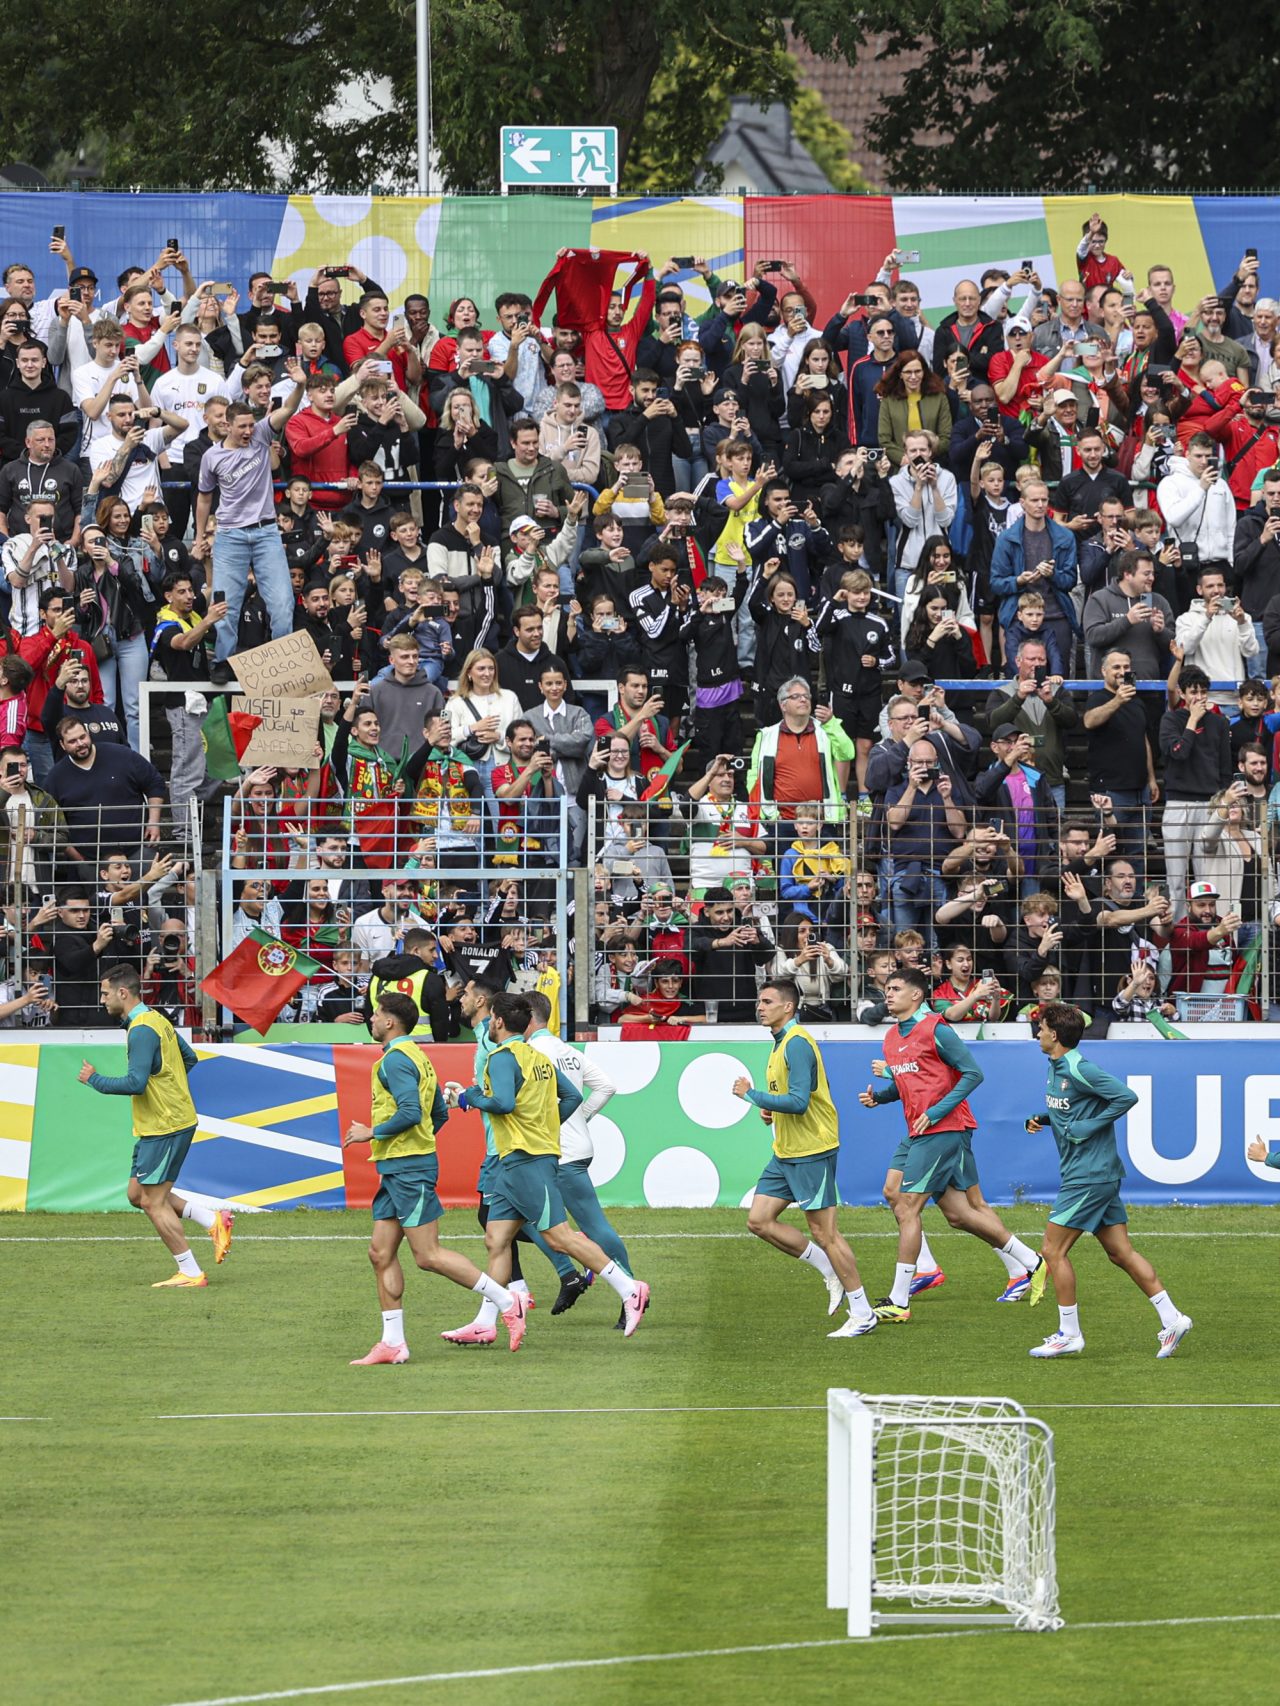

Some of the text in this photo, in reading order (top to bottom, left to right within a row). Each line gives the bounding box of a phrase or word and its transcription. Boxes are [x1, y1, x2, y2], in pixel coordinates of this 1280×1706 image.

[261, 660, 303, 680] casa
[236, 698, 281, 717] VISEU
[254, 718, 300, 731] TUGAL
[461, 946, 500, 958] RONALDO
[469, 958, 490, 974] 7
[895, 1061, 920, 1076] SAGRES
